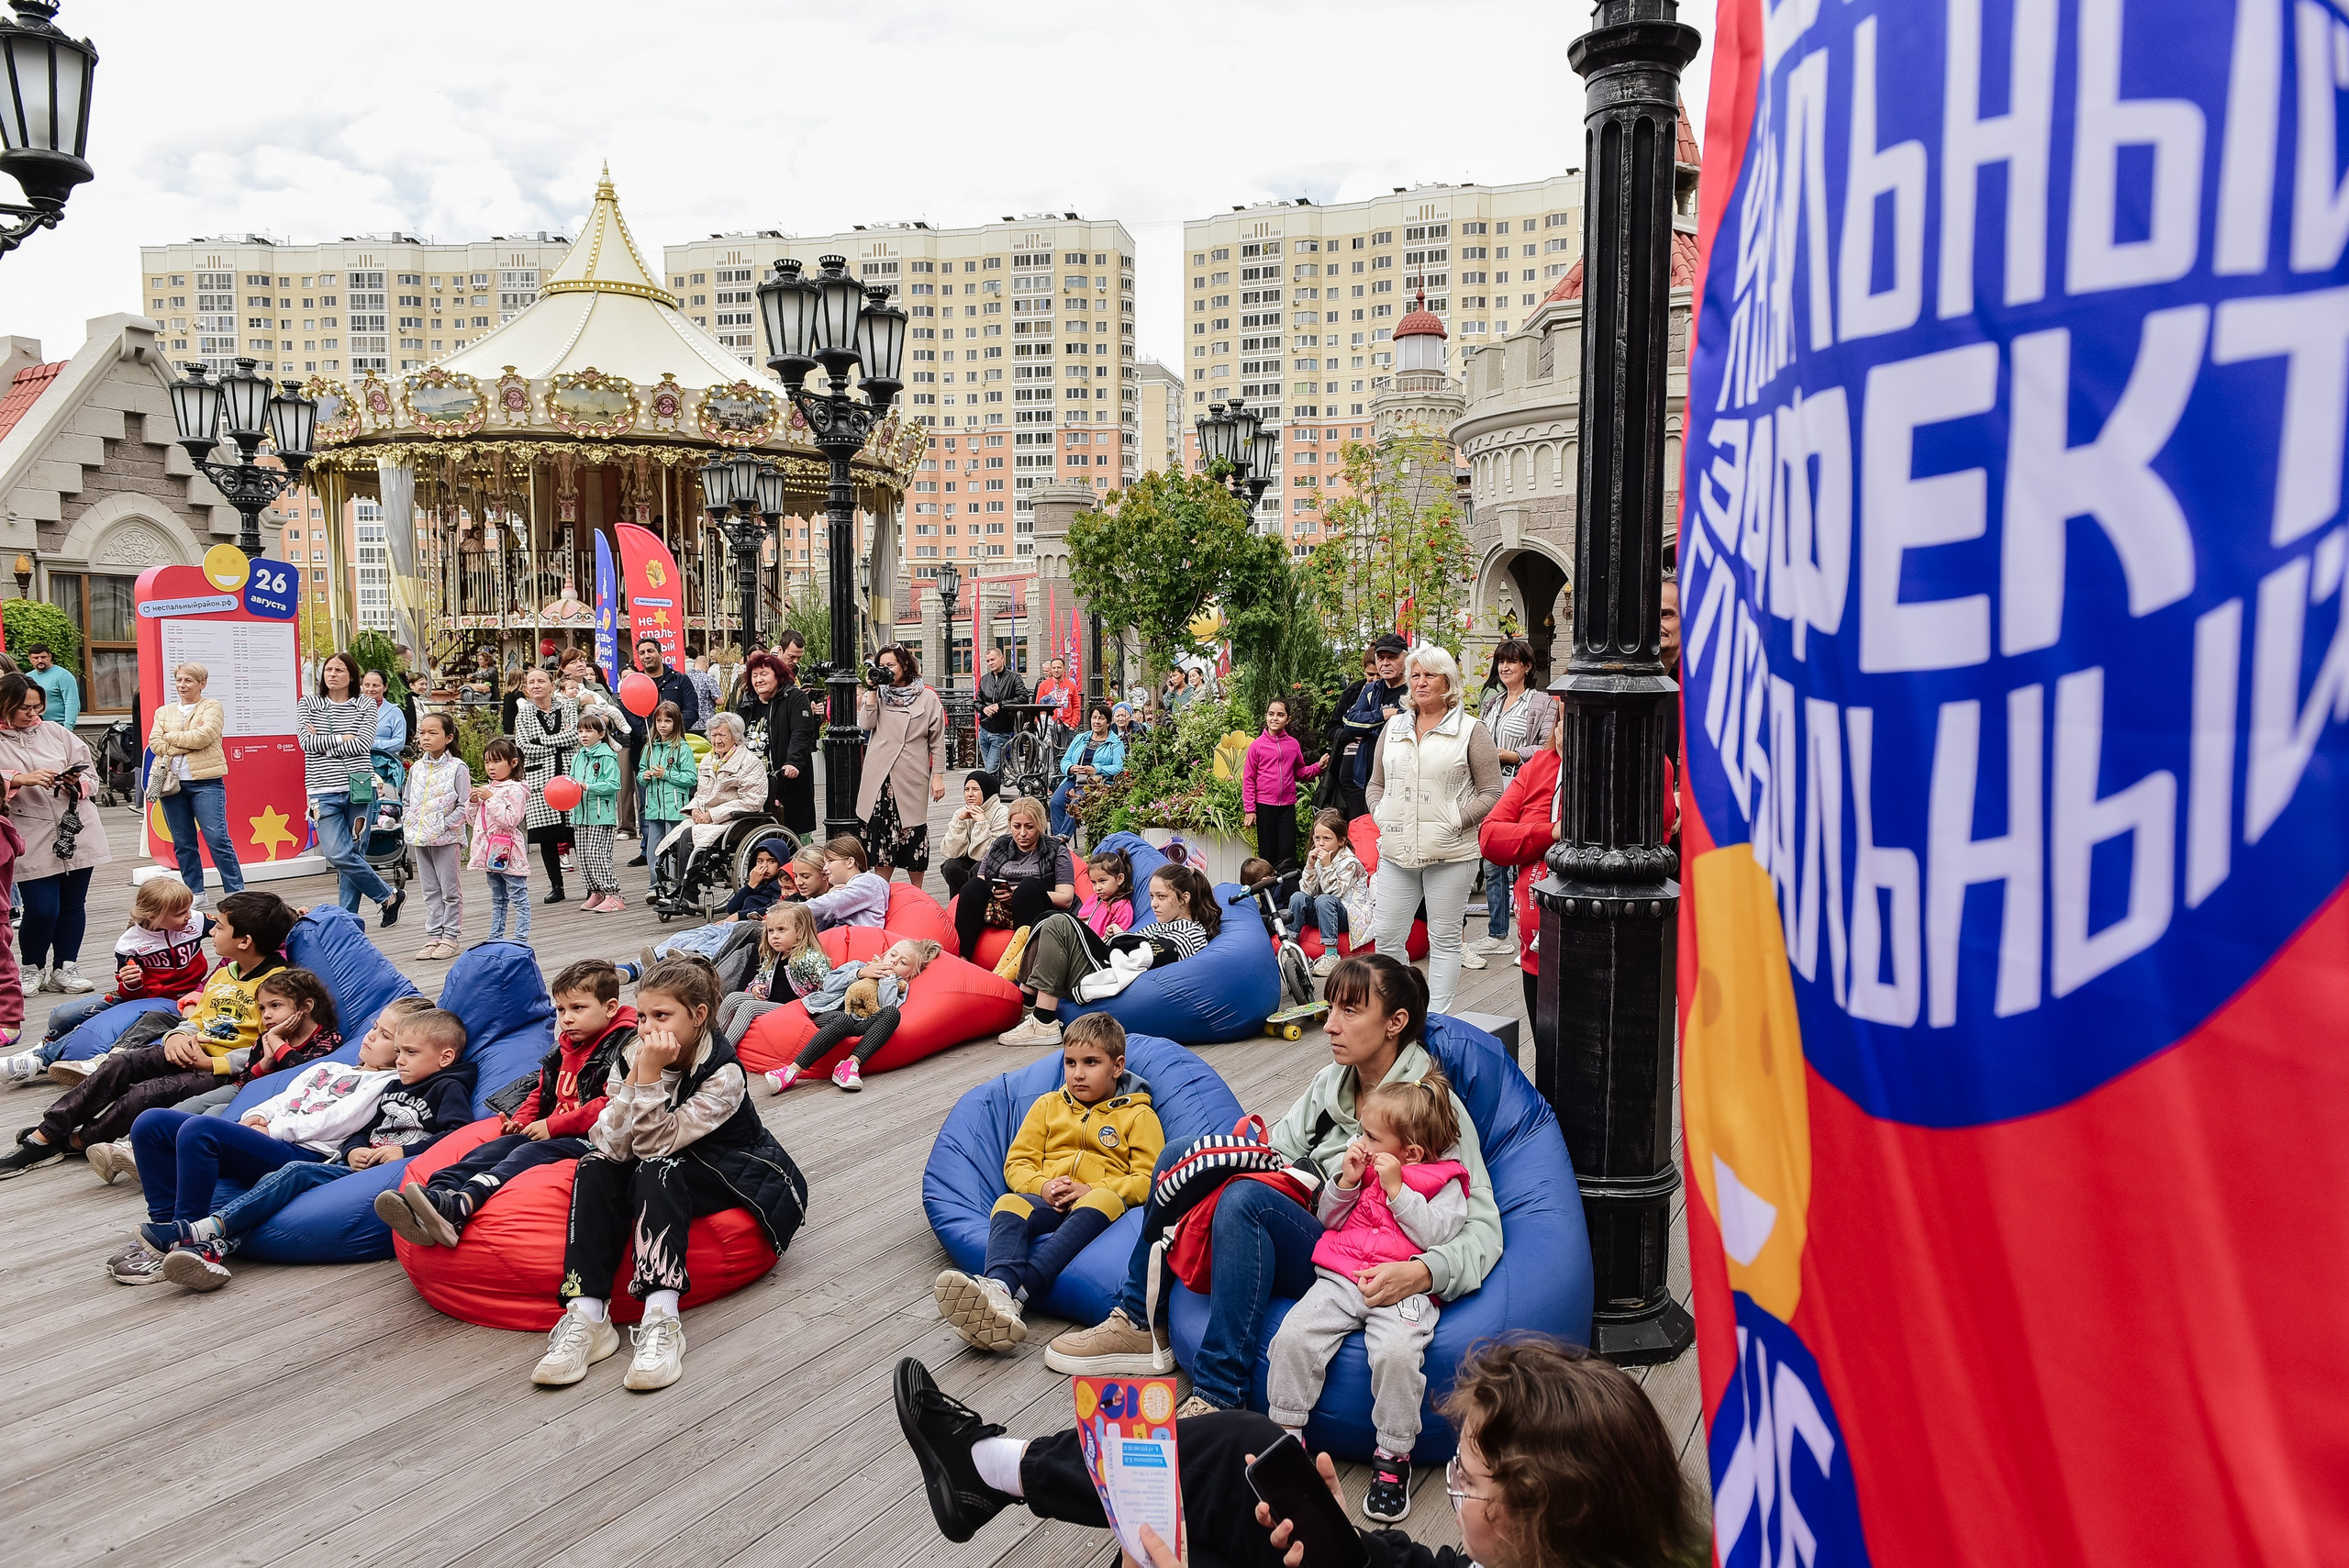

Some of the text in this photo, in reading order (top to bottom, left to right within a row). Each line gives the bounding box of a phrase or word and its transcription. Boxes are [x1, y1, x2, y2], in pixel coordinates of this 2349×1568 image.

[255, 569, 287, 594] 26
[152, 599, 232, 612] неспальныйрайон.рф
[250, 595, 287, 611] августа
[138, 941, 197, 967] RUSSI
